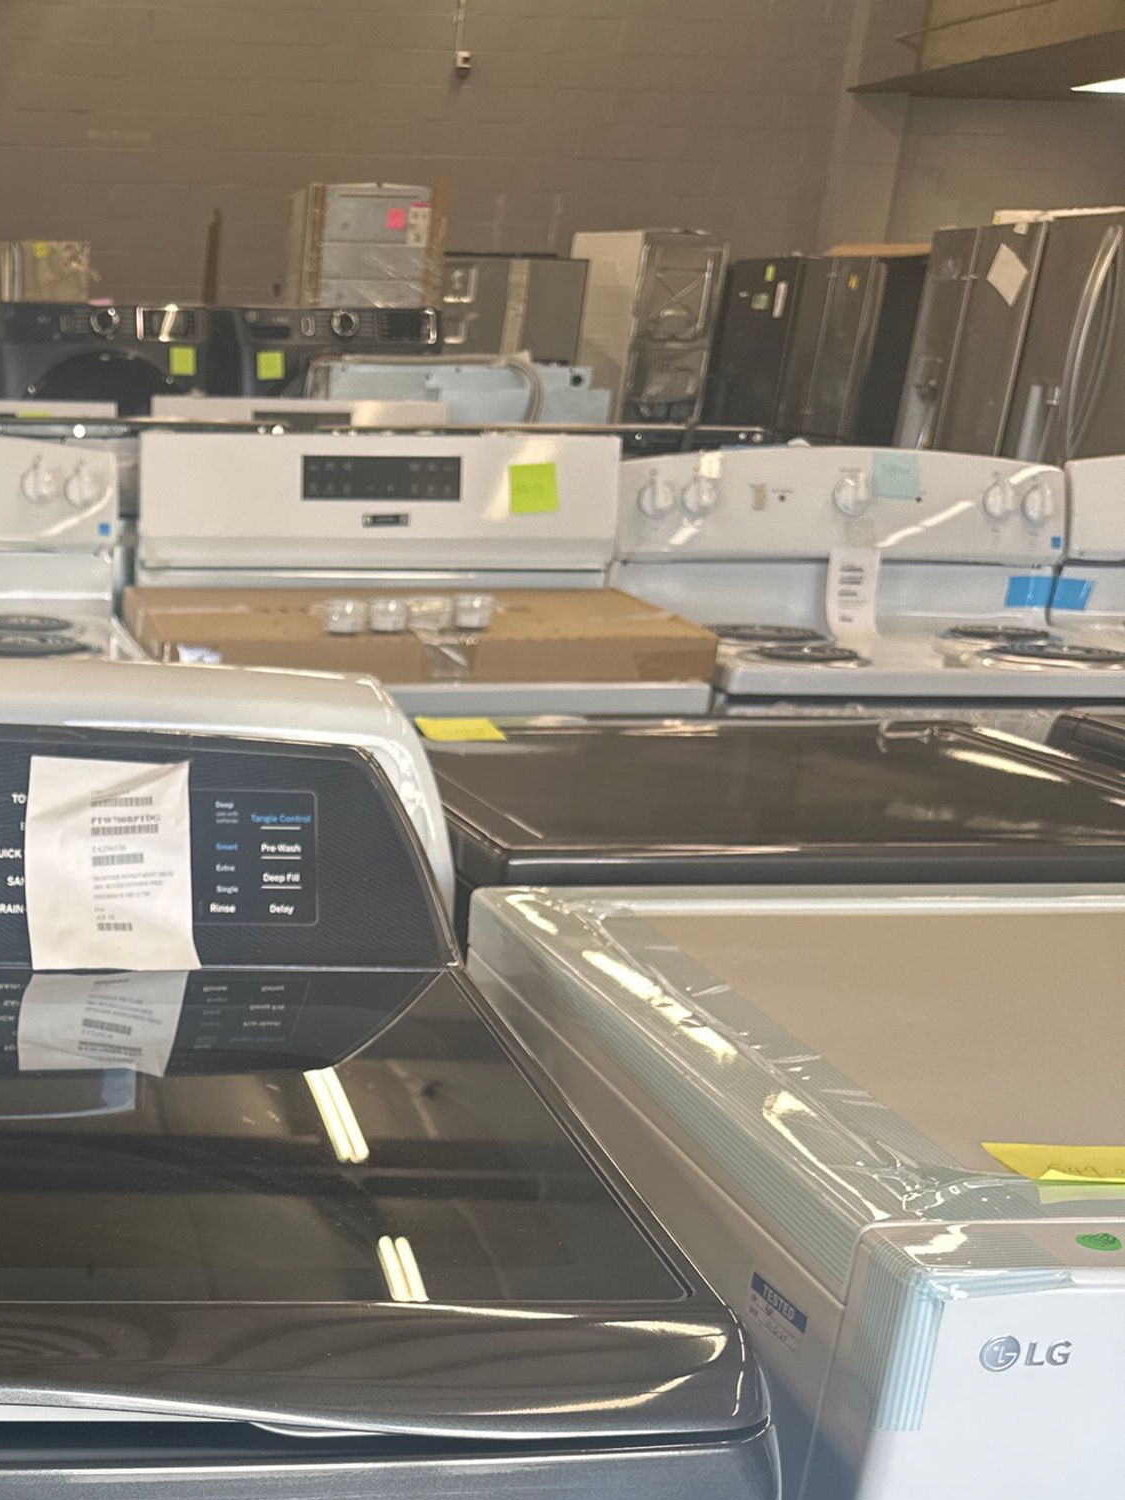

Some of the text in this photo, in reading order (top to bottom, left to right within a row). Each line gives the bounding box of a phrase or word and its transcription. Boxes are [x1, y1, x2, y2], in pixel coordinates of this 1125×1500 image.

[215, 801, 234, 809] Deep
[251, 813, 312, 823] Tangle Control
[261, 843, 302, 853] Pre-Wash
[216, 864, 235, 872] Extra
[263, 873, 300, 883] Deep Fill
[216, 884, 239, 894] Single
[210, 902, 236, 914] Rinse
[269, 903, 295, 915] Delay
[762, 1284, 795, 1320] TESTED
[1024, 1341, 1072, 1366] LG
